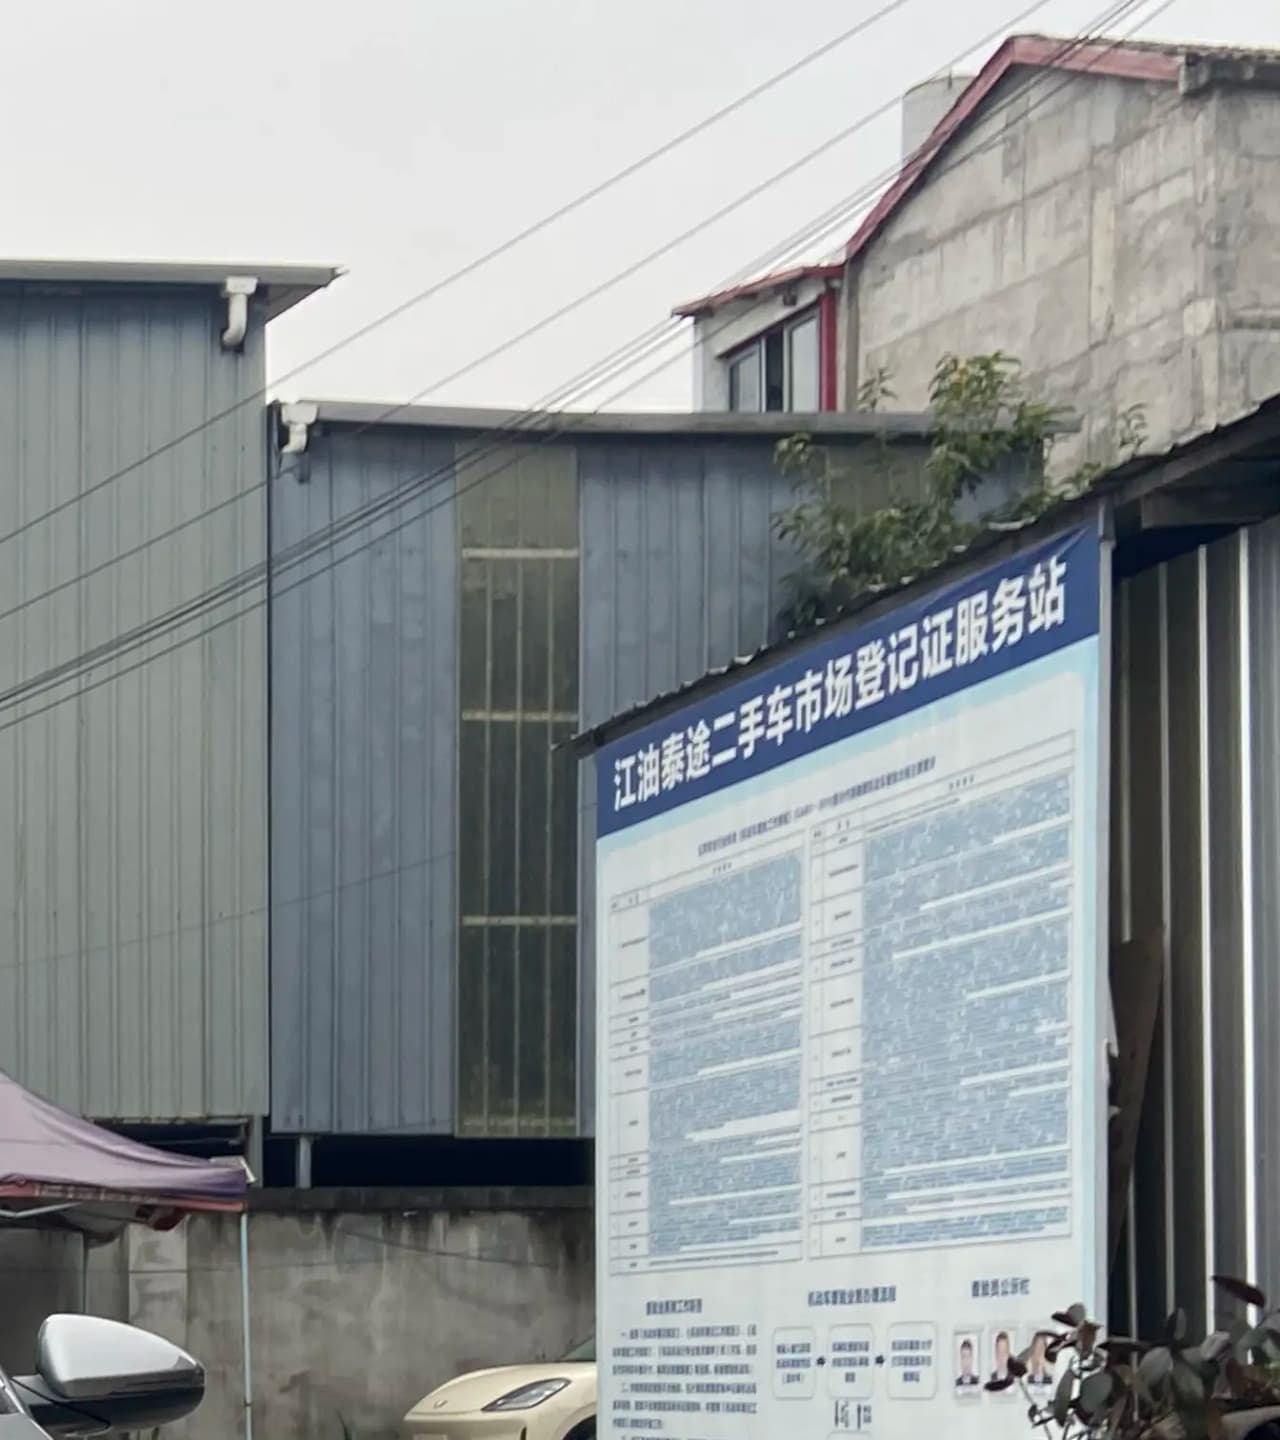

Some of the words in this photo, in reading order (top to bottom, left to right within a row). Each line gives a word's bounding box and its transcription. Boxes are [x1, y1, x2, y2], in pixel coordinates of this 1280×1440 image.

[614, 555, 1067, 812] 江油泰途二手车市场登记证服务站
